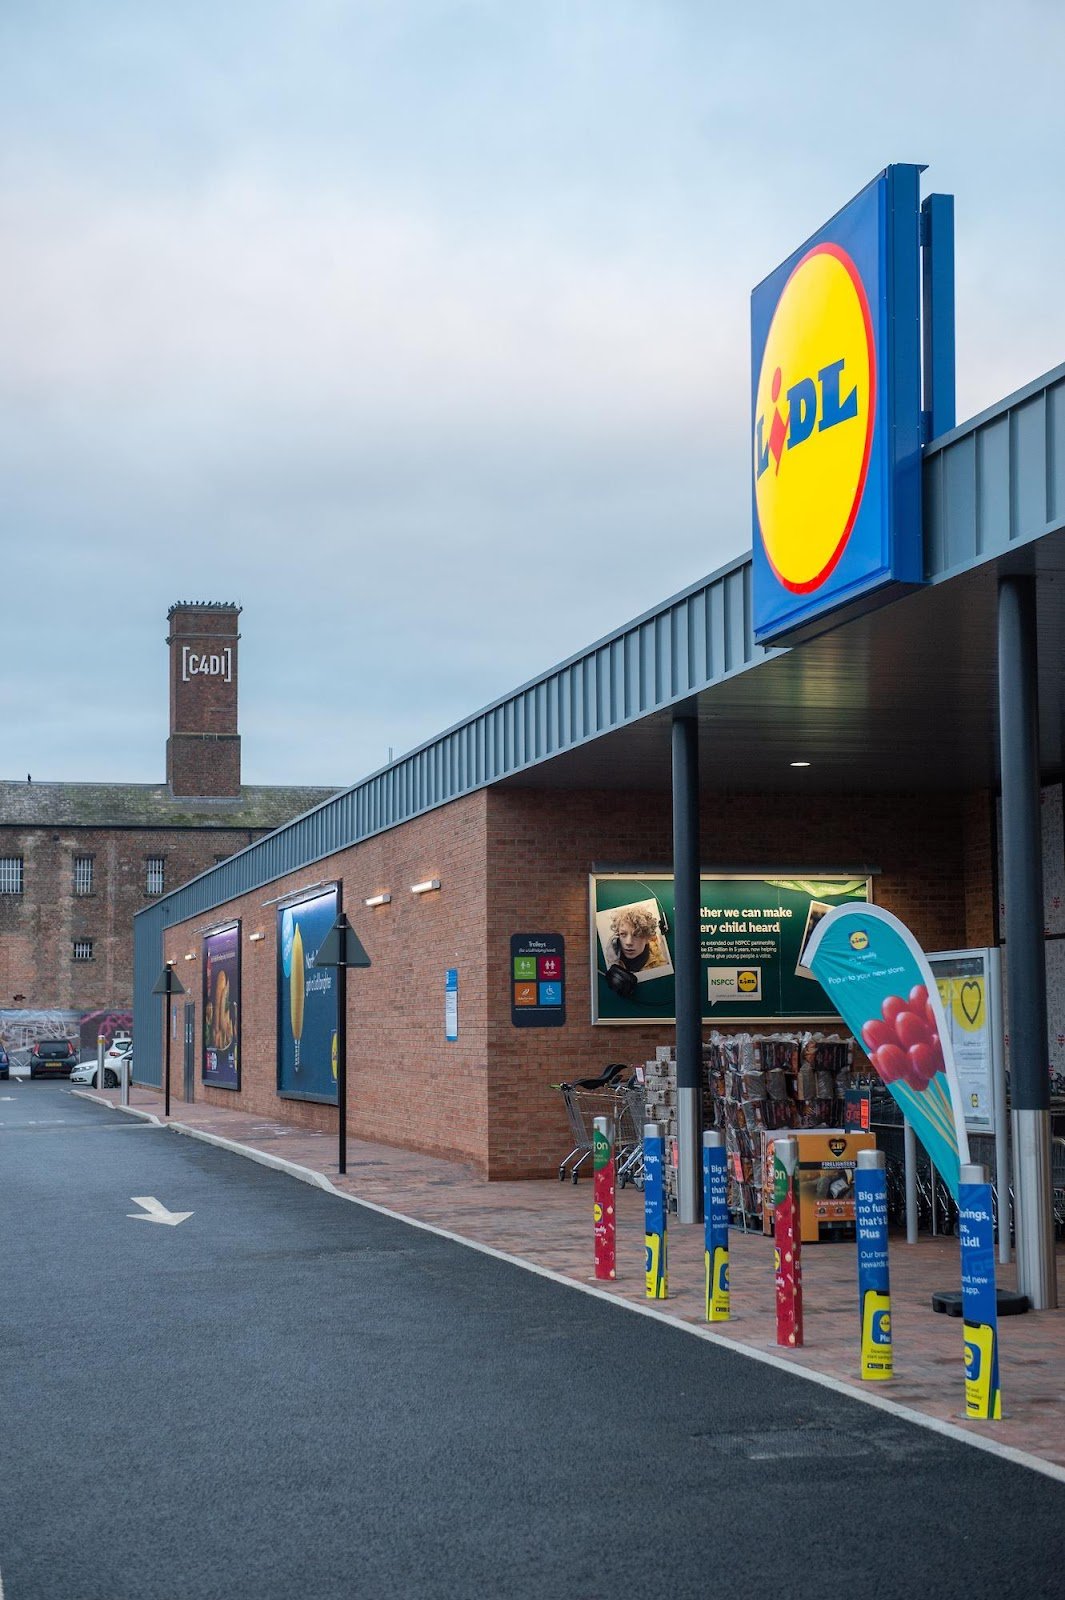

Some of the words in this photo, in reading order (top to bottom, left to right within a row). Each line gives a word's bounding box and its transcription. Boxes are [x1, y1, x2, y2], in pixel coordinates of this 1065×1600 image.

[724, 909, 740, 918] we
[741, 909, 761, 918] can
[763, 906, 793, 918] make
[700, 924, 717, 936] ery
[719, 921, 747, 933] child
[748, 921, 780, 933] heard
[828, 976, 841, 985] Pop
[872, 969, 887, 977] new
[596, 1141, 608, 1150] on
[830, 1141, 845, 1151] ZIP
[711, 1164, 722, 1175] Big
[774, 1169, 786, 1180] on
[858, 1190, 874, 1203] Big
[858, 1205, 870, 1213] no
[859, 1216, 882, 1226] that's
[860, 1229, 881, 1239] Plus
[963, 1236, 981, 1248] Lidl
[860, 1250, 874, 1259] Our
[972, 1276, 988, 1285] new
